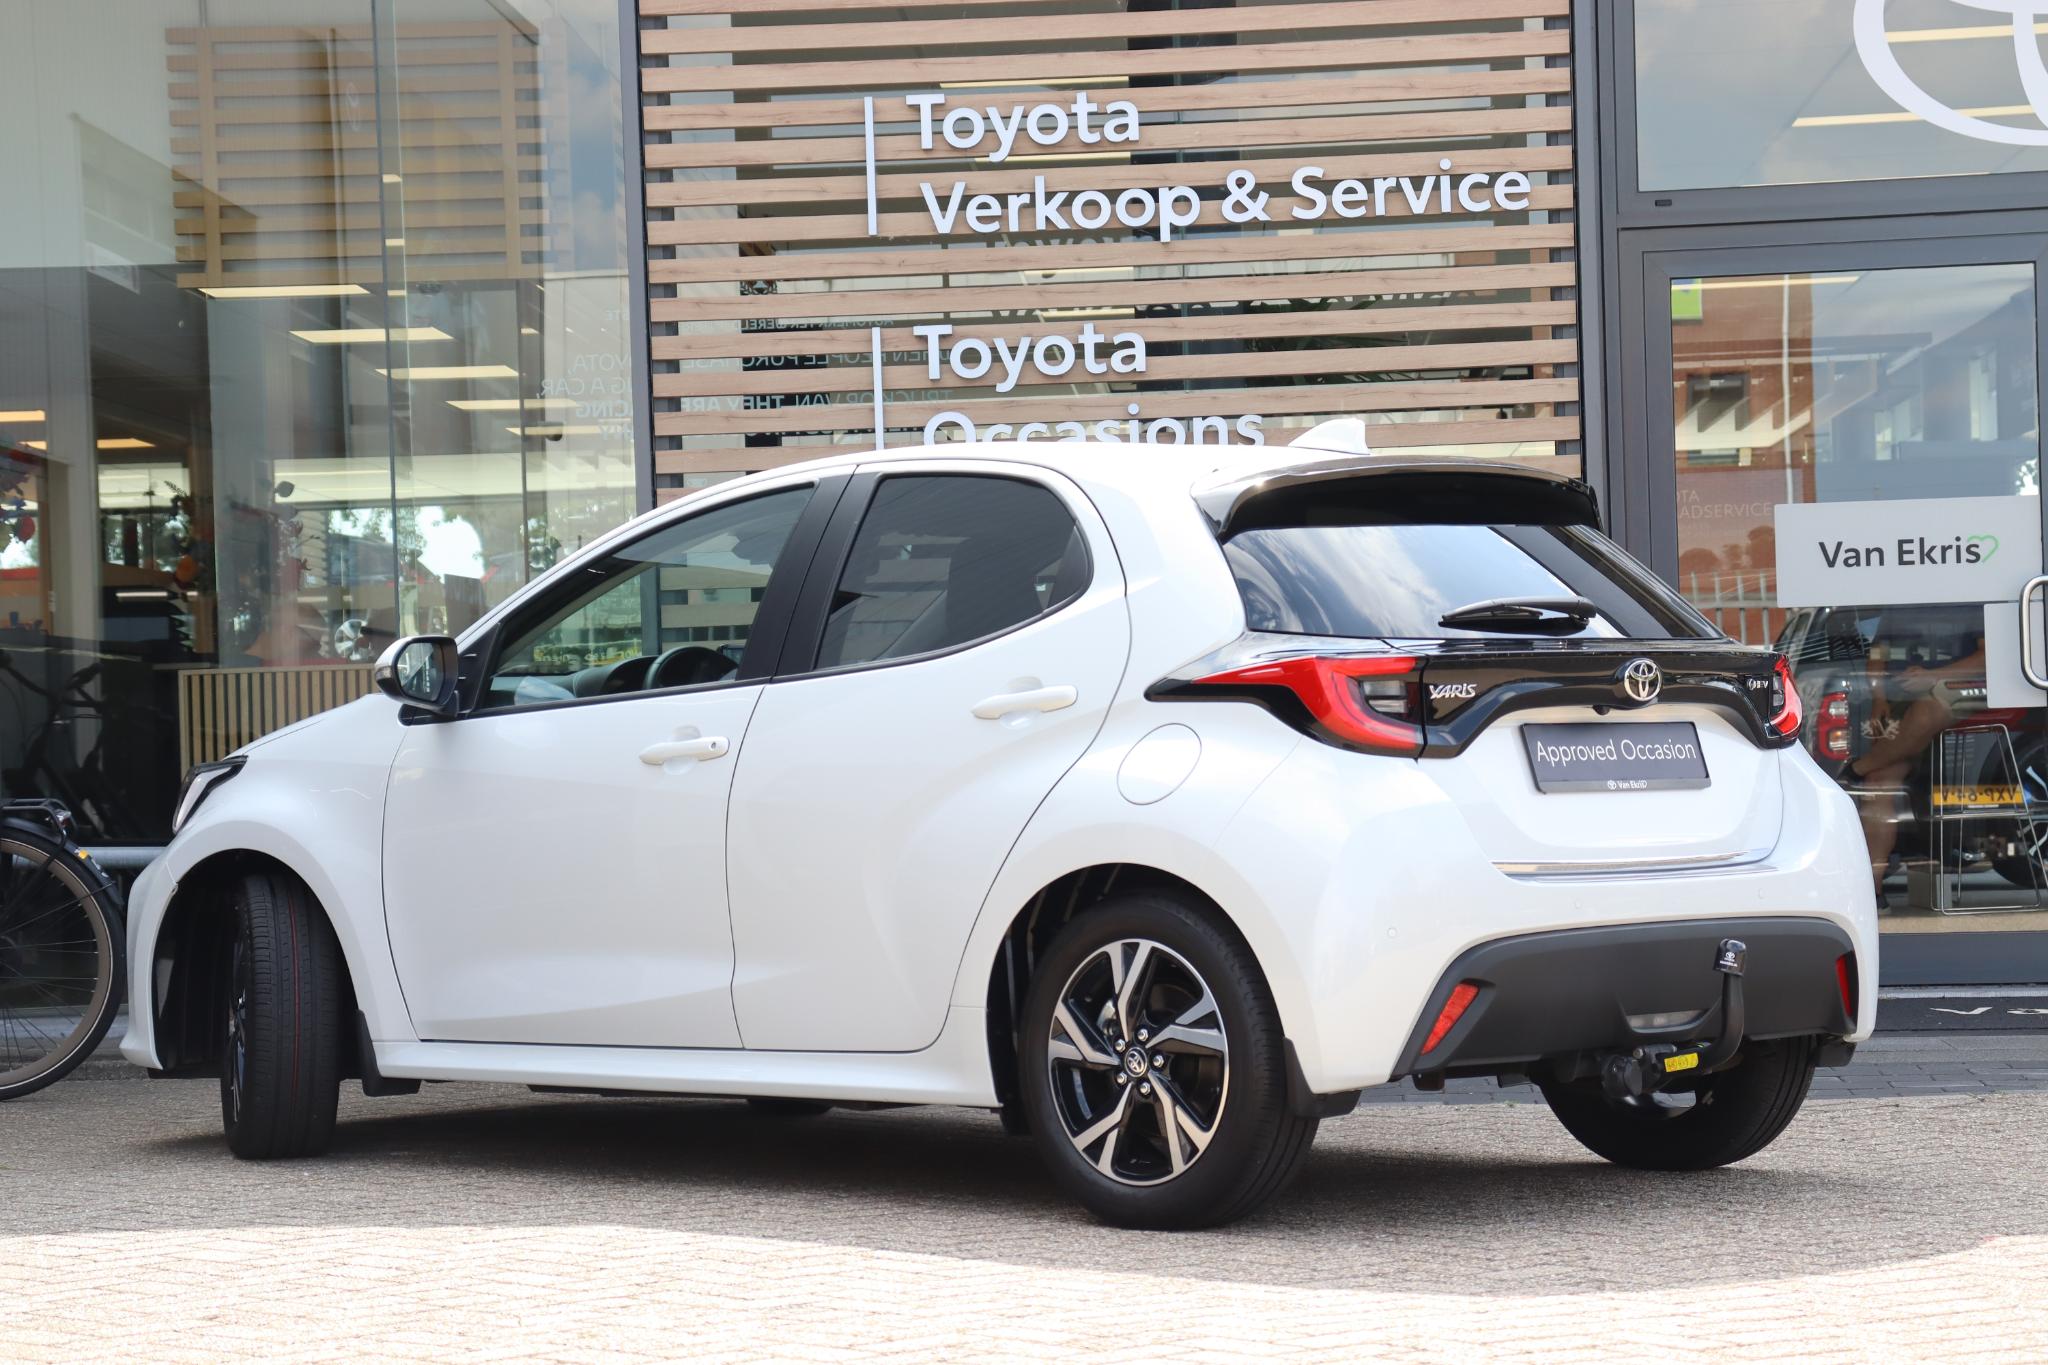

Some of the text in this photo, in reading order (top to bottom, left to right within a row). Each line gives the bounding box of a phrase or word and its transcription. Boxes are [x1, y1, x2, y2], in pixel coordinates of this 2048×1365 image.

[905, 92, 1140, 163] Toyota
[919, 158, 1532, 243] Verkoop & Service
[912, 322, 1147, 393] Toyota
[1818, 535, 1982, 568] Van Ekris
[1536, 738, 1697, 768] Approved Occasion
